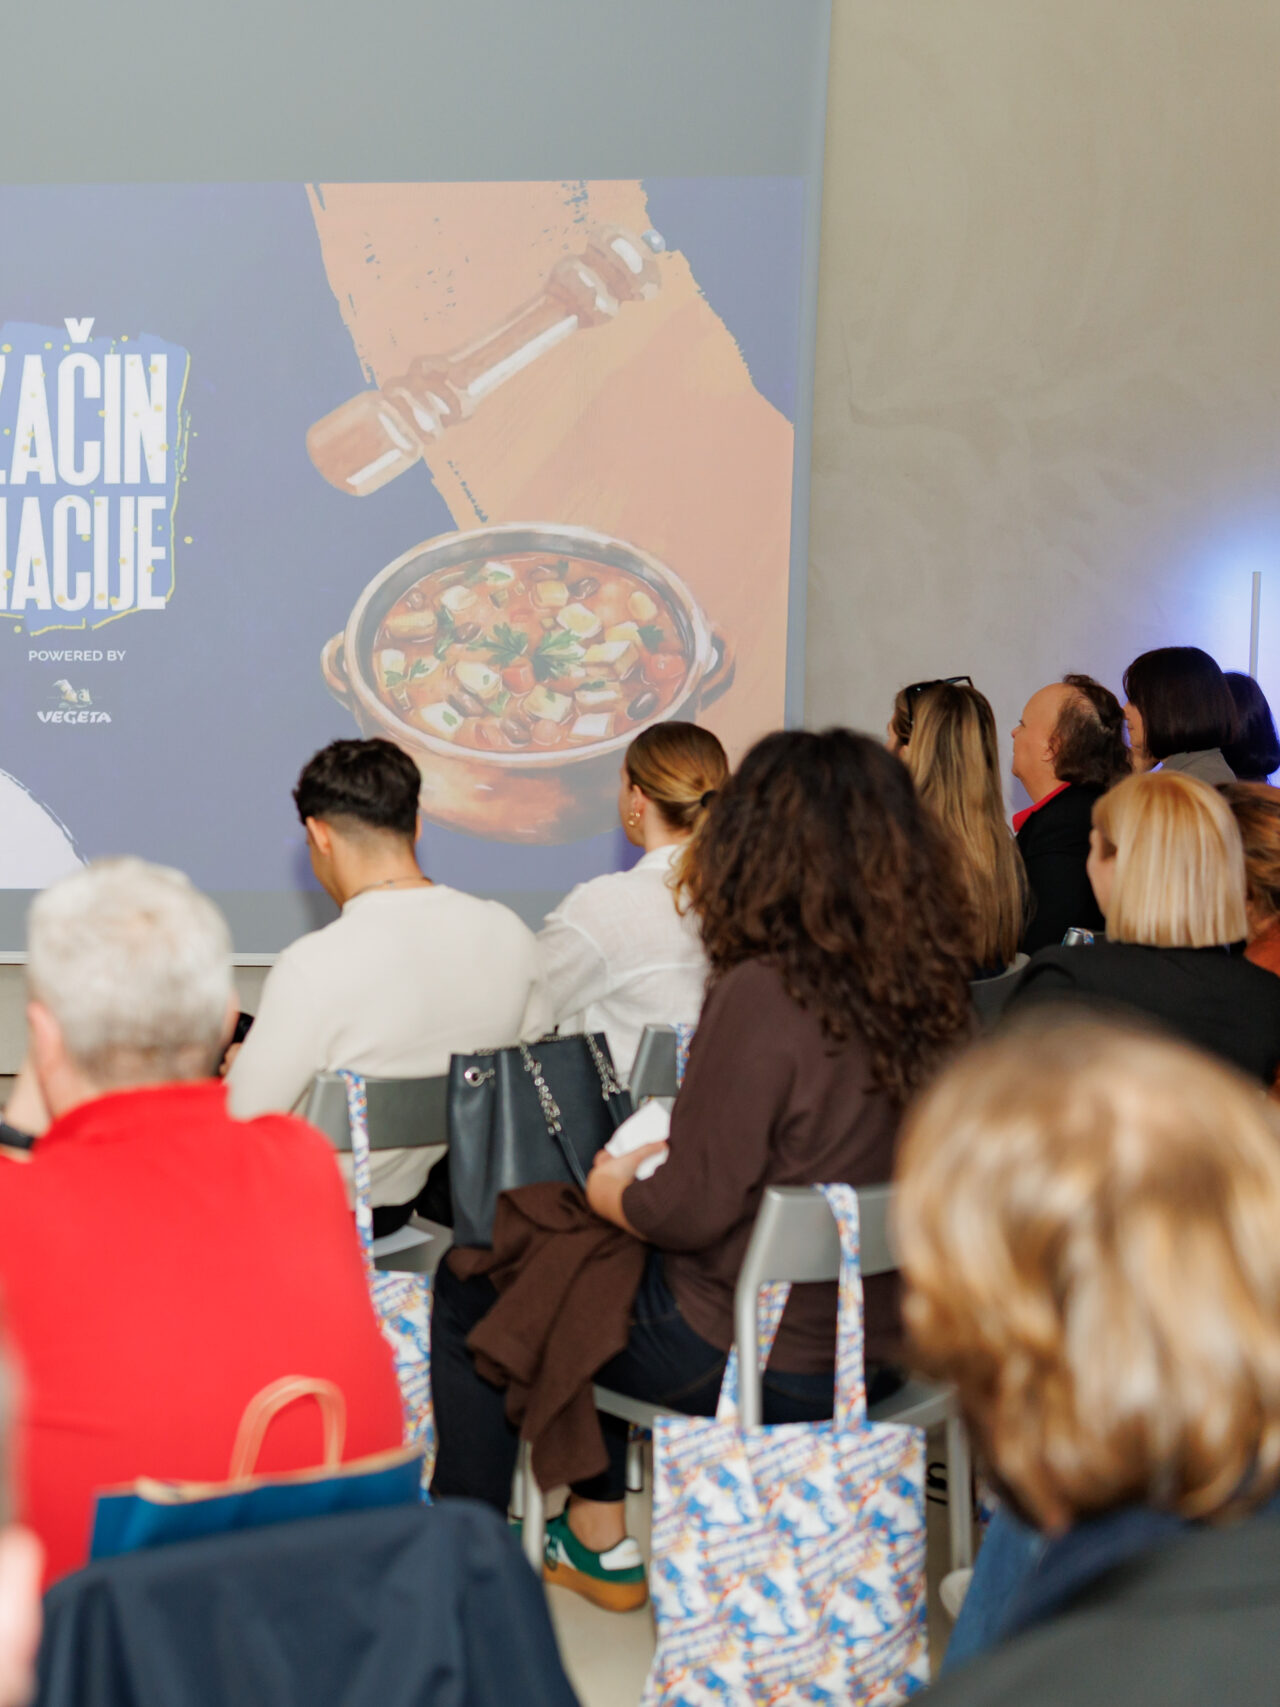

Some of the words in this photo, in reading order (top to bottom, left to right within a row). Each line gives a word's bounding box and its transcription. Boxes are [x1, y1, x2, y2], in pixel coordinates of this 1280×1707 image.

[28, 650, 103, 661] POWERED
[107, 650, 126, 661] BY
[37, 710, 112, 725] VEGETA
